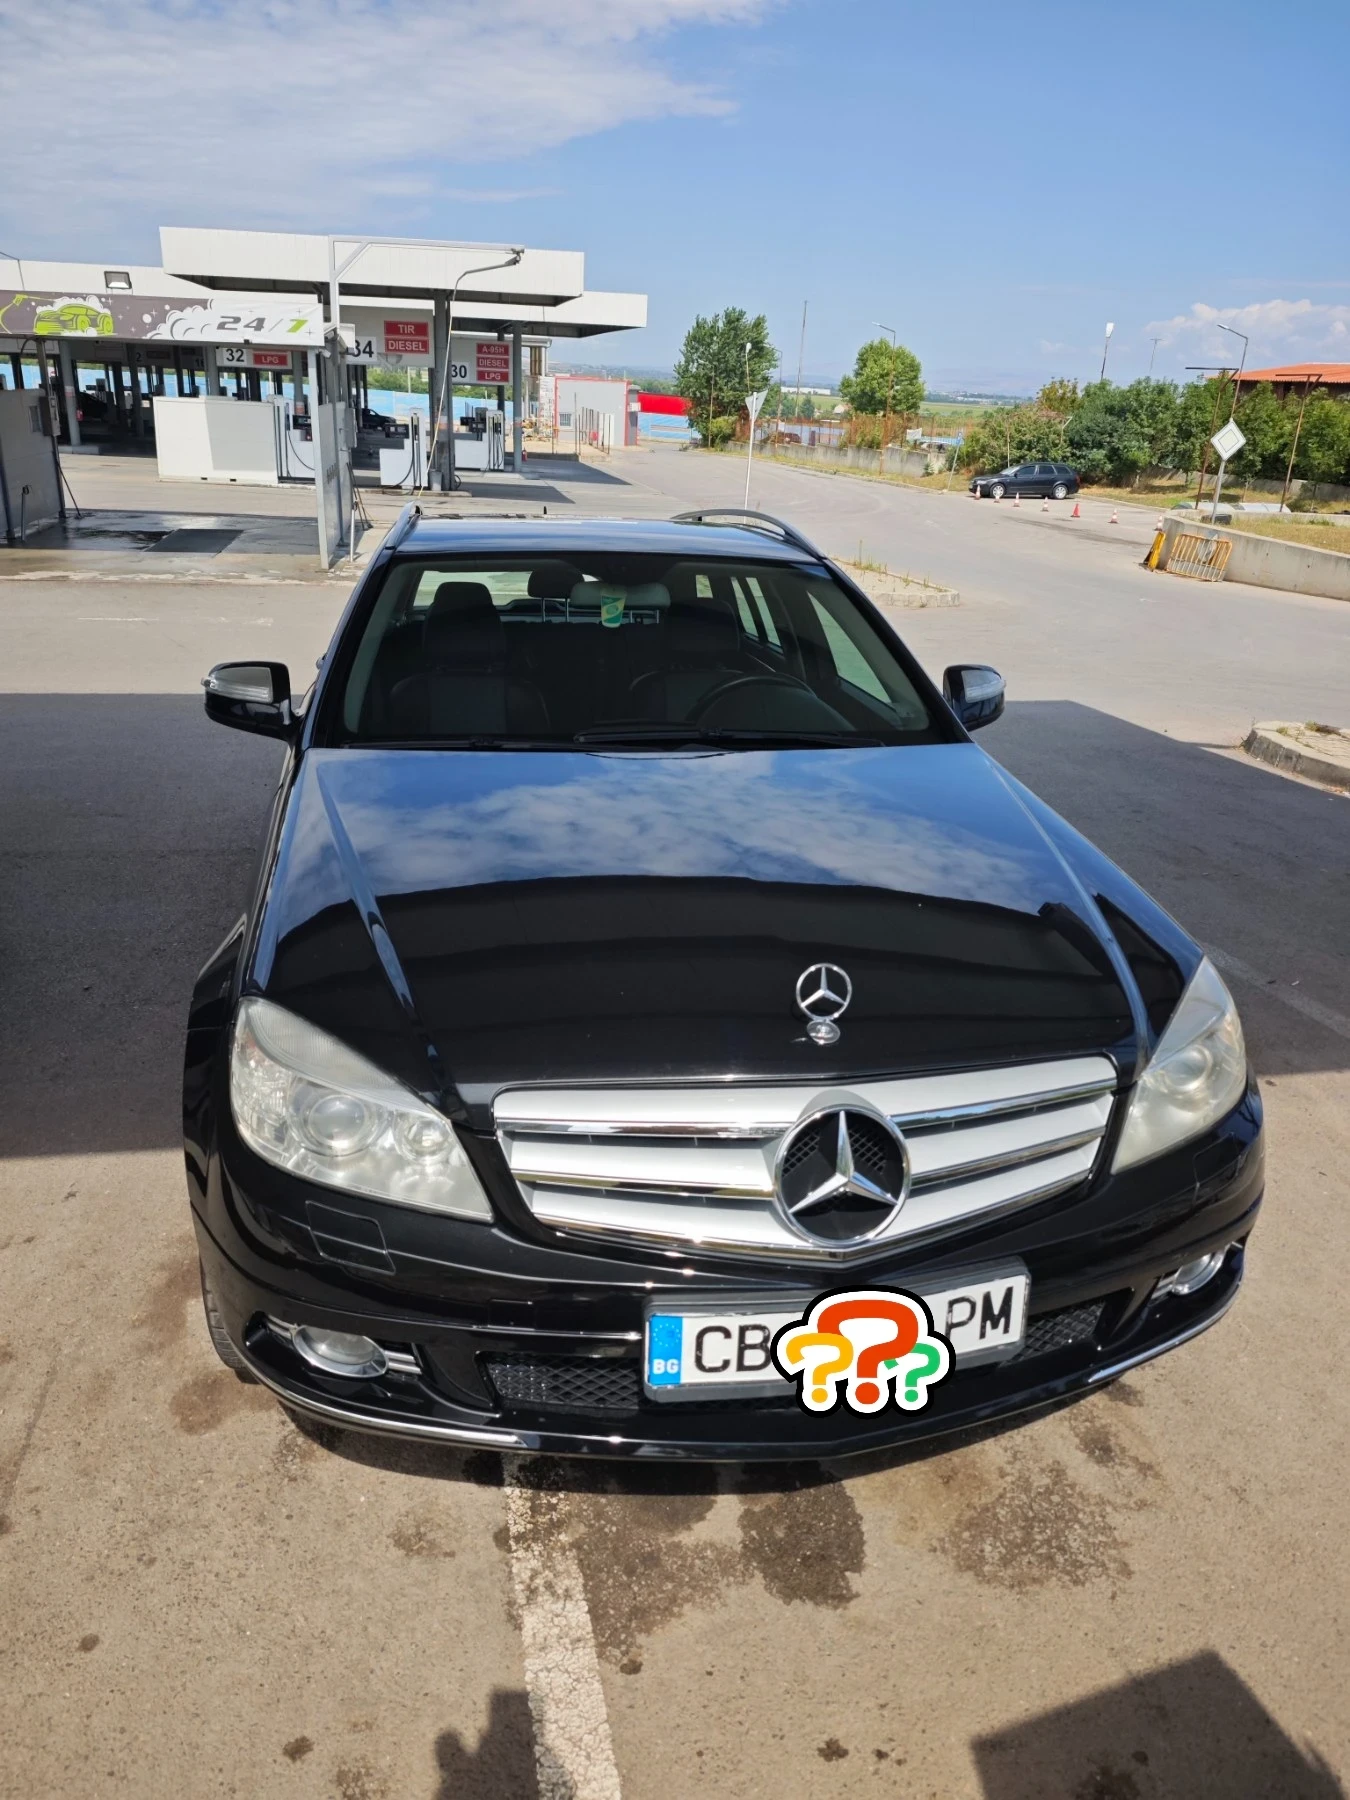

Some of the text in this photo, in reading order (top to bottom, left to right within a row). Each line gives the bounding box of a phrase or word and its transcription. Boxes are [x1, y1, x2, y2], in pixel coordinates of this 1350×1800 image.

[216, 316, 309, 333] 24/7
[397, 324, 415, 334] TIR
[388, 340, 425, 351] DIESEL
[225, 348, 245, 362] 32
[261, 355, 279, 364] LPG
[479, 358, 507, 368] DIESEL
[451, 364, 467, 378] 30
[484, 372, 501, 380] LPG
[695, 1286, 1014, 1373] CB PM
[653, 1359, 679, 1375] BG
